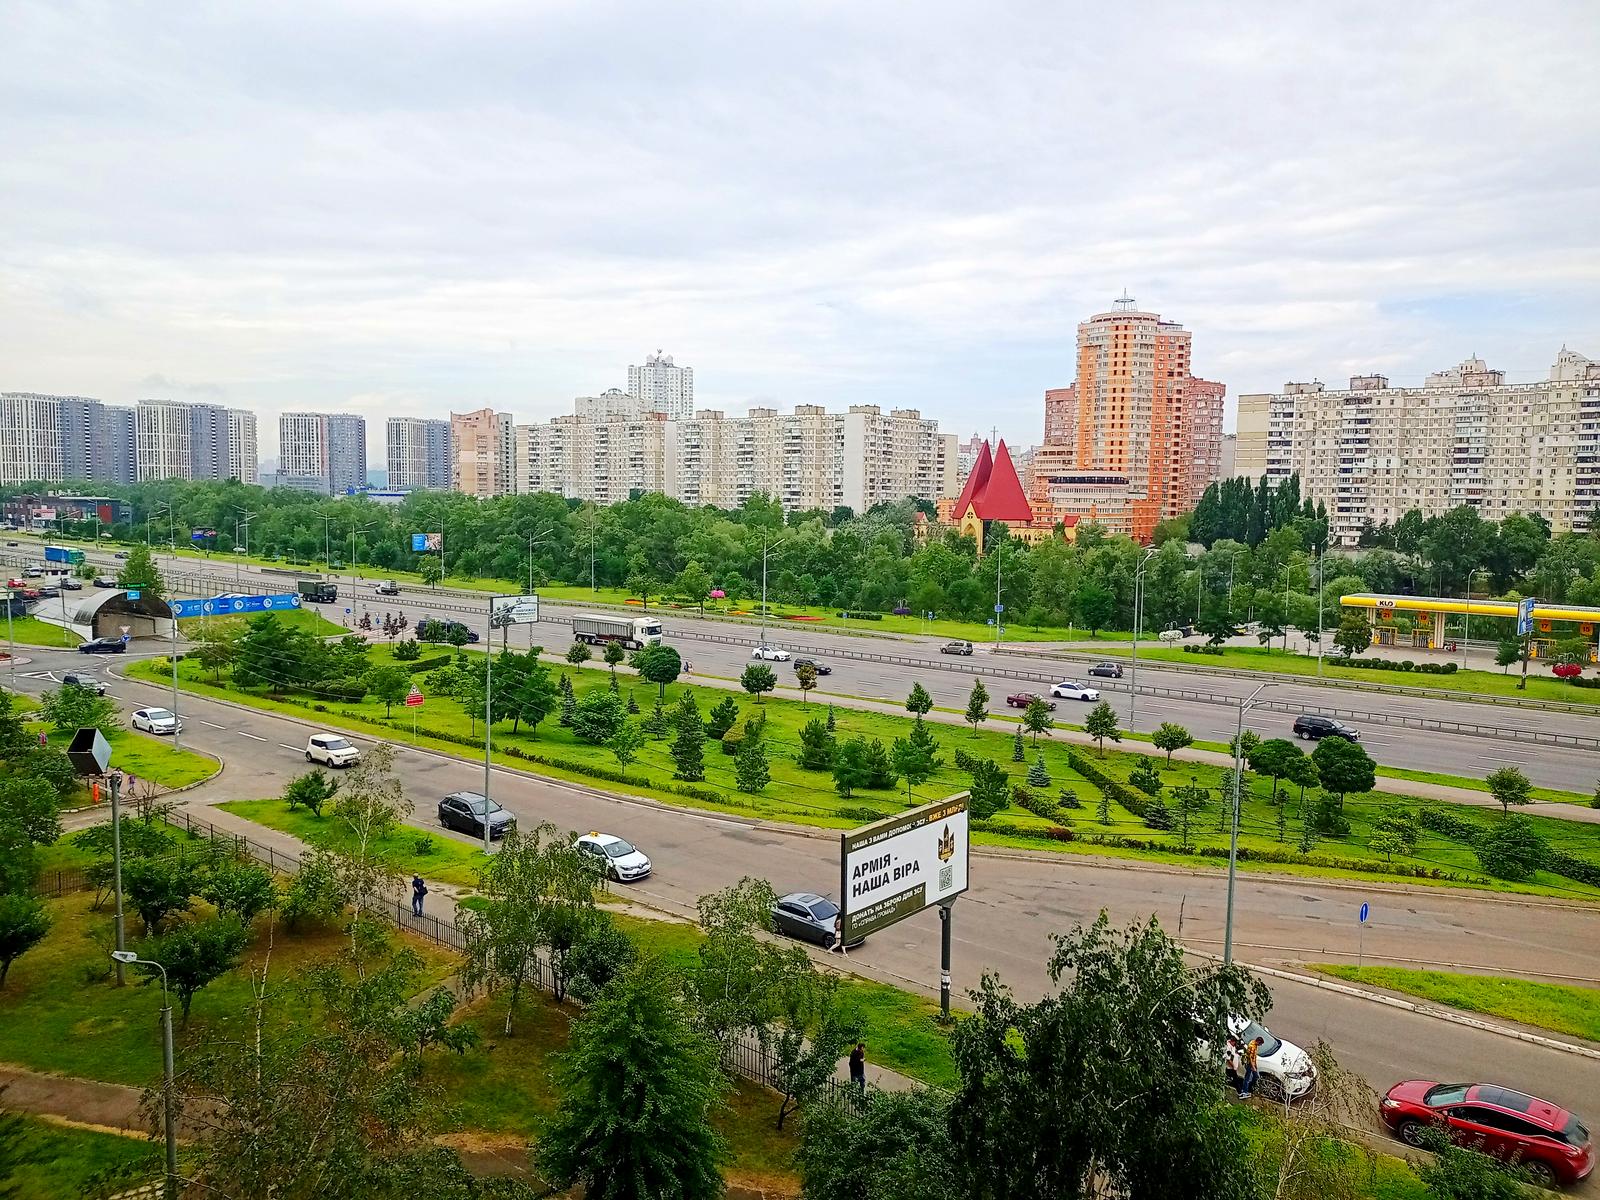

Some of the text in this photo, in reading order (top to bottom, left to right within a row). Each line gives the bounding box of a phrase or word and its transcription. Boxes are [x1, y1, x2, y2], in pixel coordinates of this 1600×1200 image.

[873, 832, 888, 842] ВАМИ
[852, 854, 890, 880] АРМІЯ
[853, 860, 920, 897] НАША ВІРА
[852, 908, 874, 923] ДОНАТЬ
[883, 896, 902, 908] ЗБРОЮ
[902, 891, 913, 901] ДЛЯ
[914, 886, 923, 895] ЗСУ
